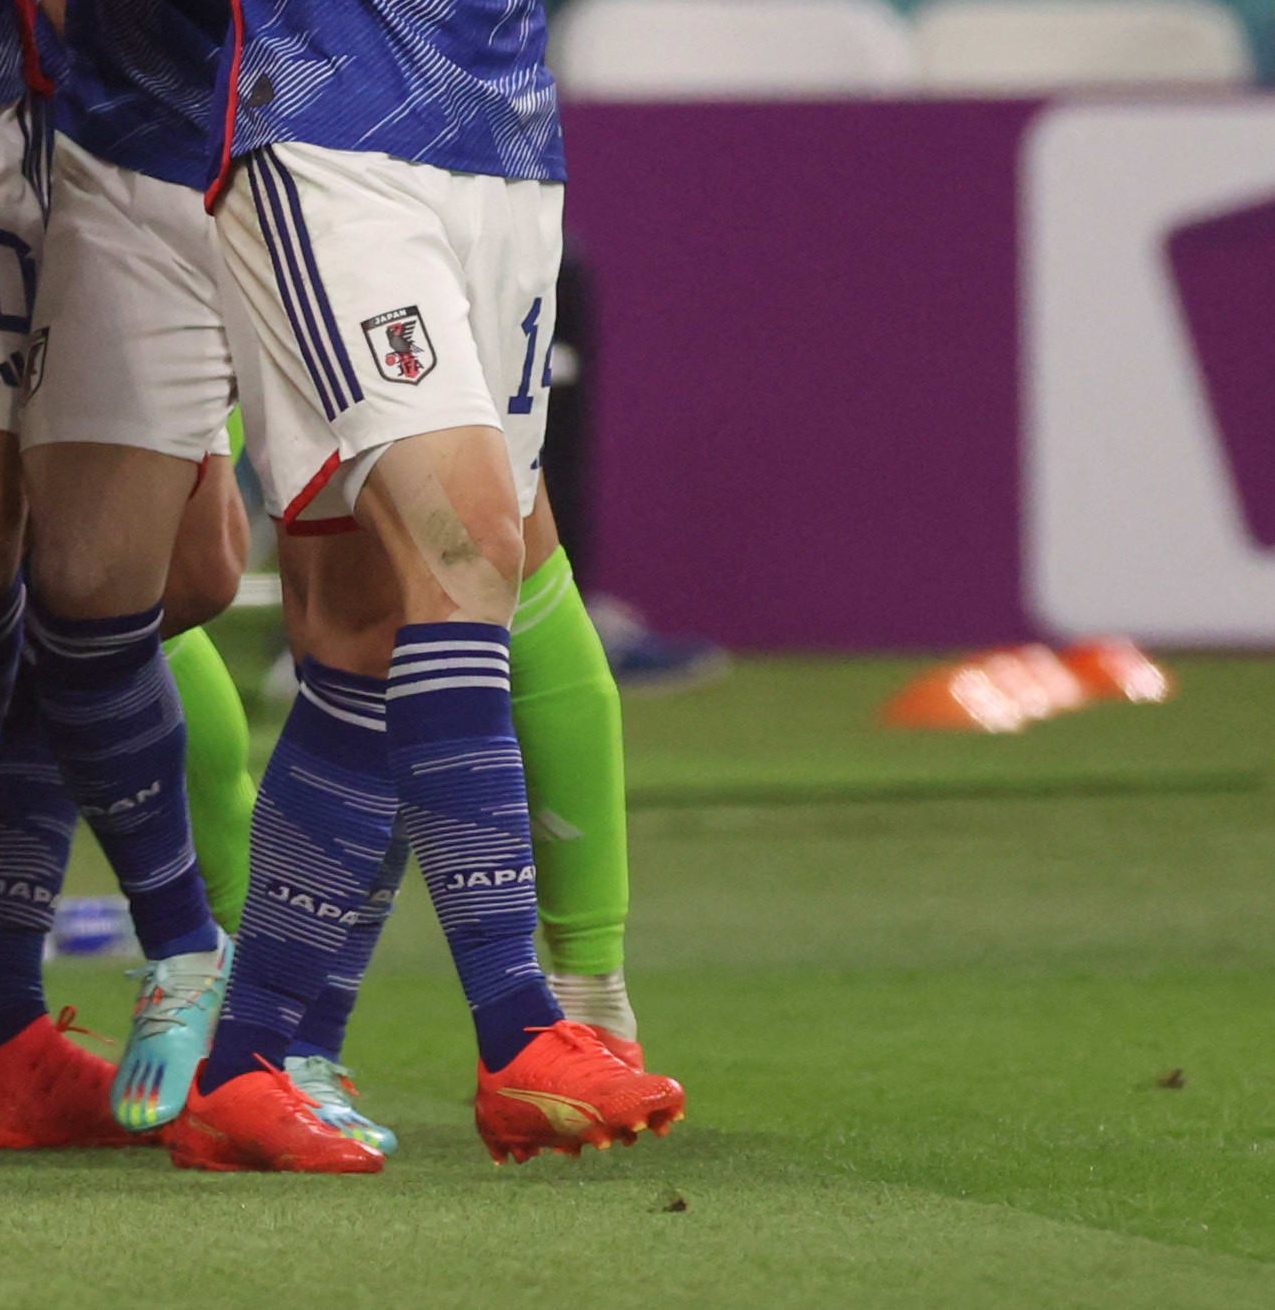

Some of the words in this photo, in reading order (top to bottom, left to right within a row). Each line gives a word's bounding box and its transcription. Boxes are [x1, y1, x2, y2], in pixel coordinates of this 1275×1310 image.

[374, 309, 407, 325] JAPAN
[447, 865, 537, 890] JAPA
[266, 886, 360, 927] JAPA
